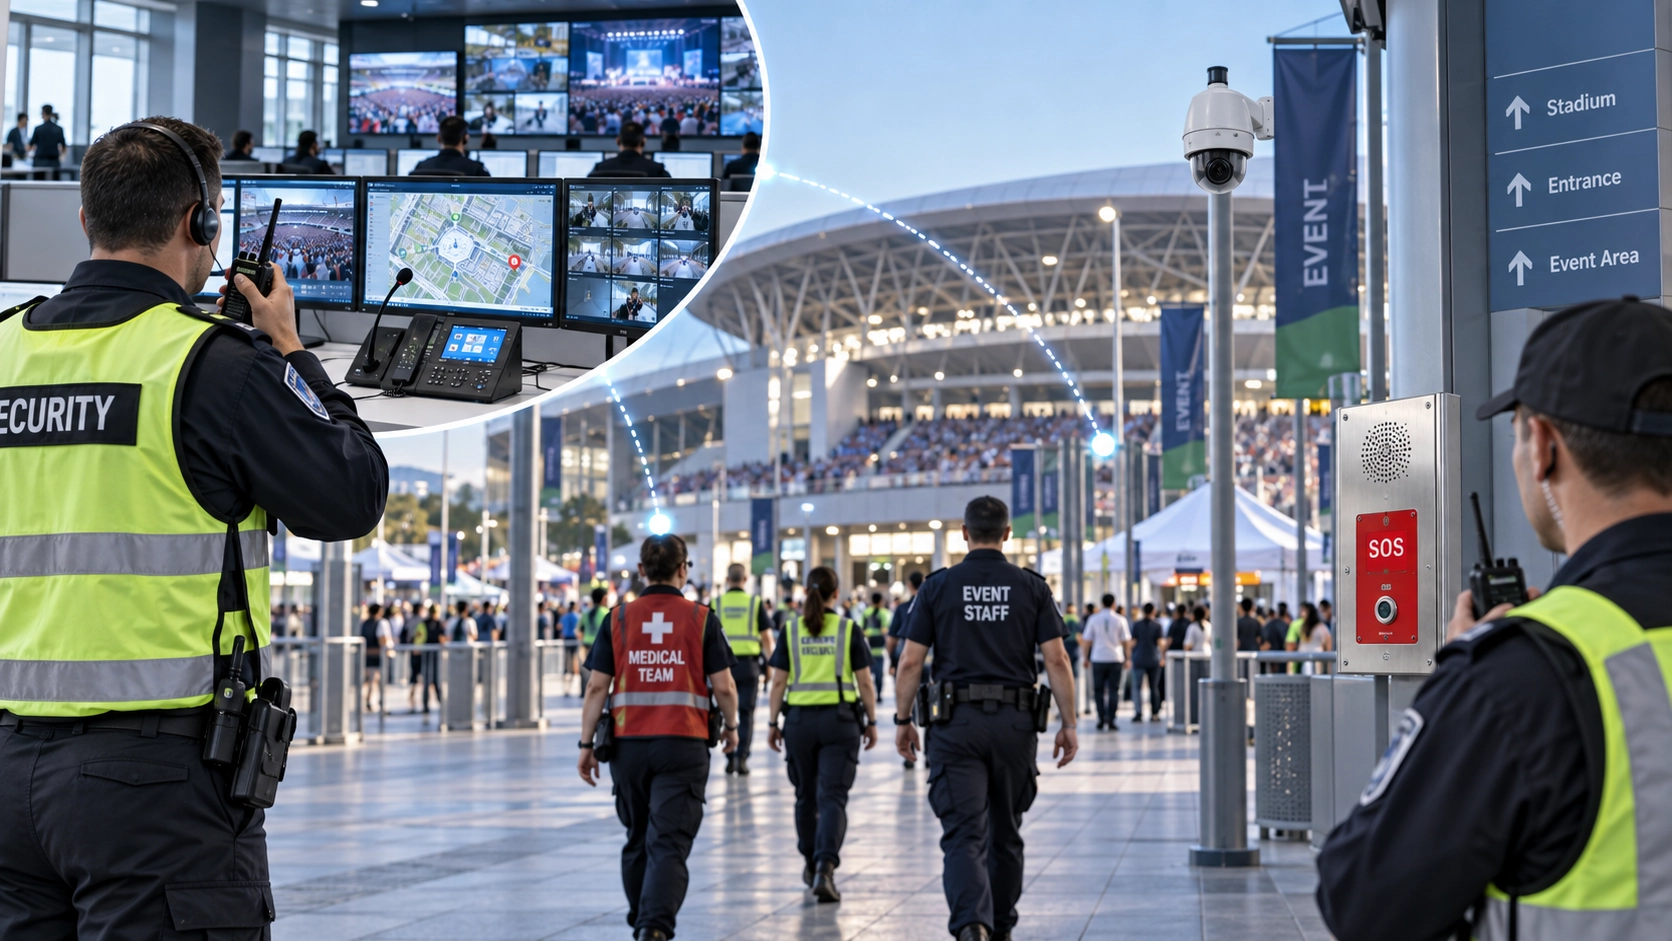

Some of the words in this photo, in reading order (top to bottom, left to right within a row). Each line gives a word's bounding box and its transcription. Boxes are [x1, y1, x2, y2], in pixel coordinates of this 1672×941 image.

[1547, 93, 1616, 116] Stadium
[1548, 171, 1622, 194] Entrance
[1303, 178, 1328, 287] EVENT
[1550, 252, 1596, 273] Event
[1600, 249, 1639, 267] Area
[1175, 370, 1191, 432] EVENT
[1369, 537, 1404, 558] SOS
[963, 586, 1011, 602] EVENT
[964, 604, 1010, 621] STAFF
[628, 650, 686, 665] MEDICAL
[638, 667, 674, 682] TEAM
